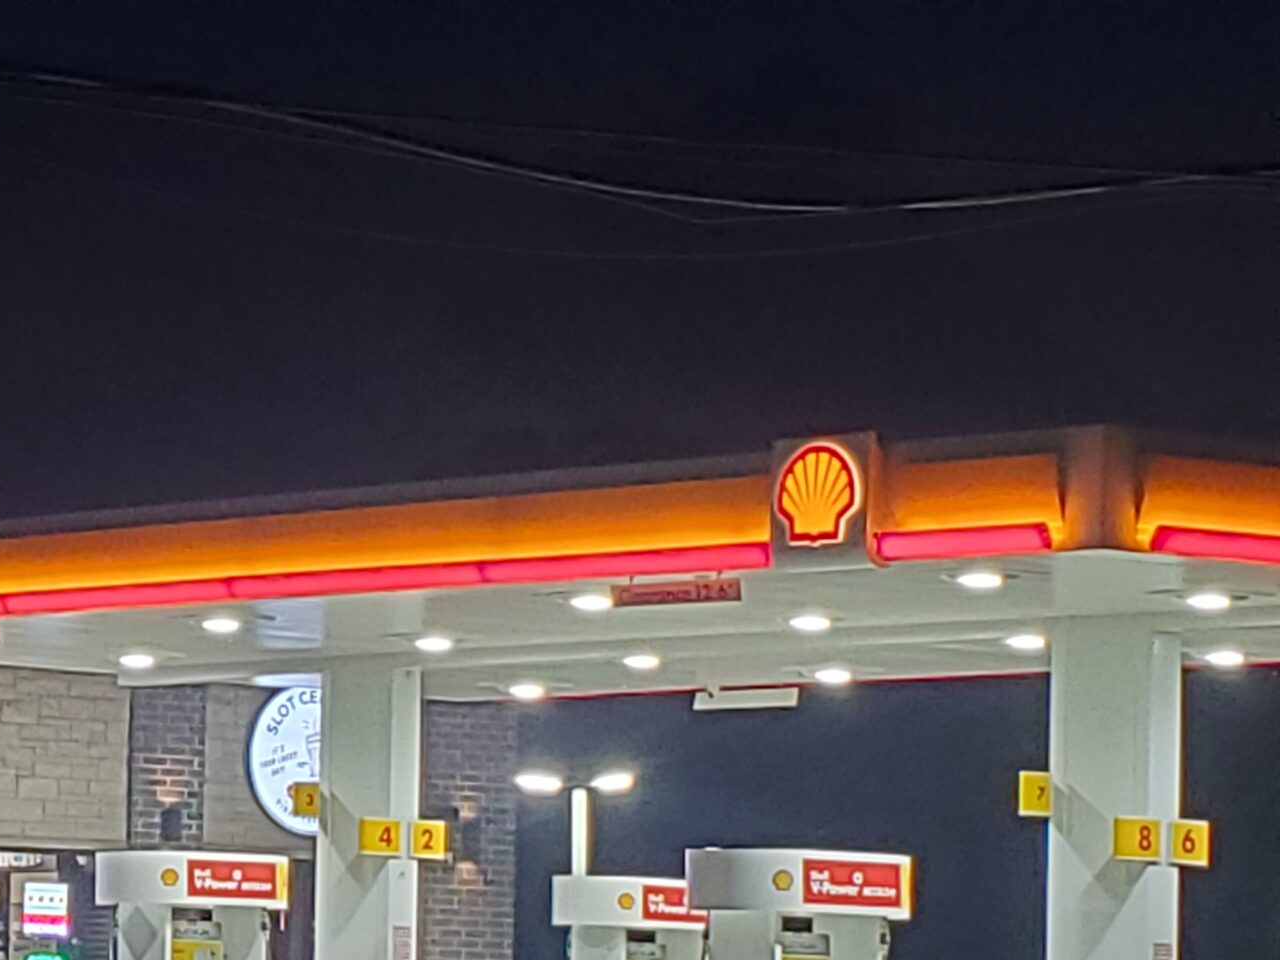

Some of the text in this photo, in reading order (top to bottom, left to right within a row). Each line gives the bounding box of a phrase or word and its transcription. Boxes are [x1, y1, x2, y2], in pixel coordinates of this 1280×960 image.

[266, 696, 296, 736] SLOT
[1037, 786, 1045, 800] 7
[379, 826, 392, 847] 4
[421, 829, 433, 850] 2
[1138, 826, 1152, 851] 8
[1181, 829, 1195, 854] 6
